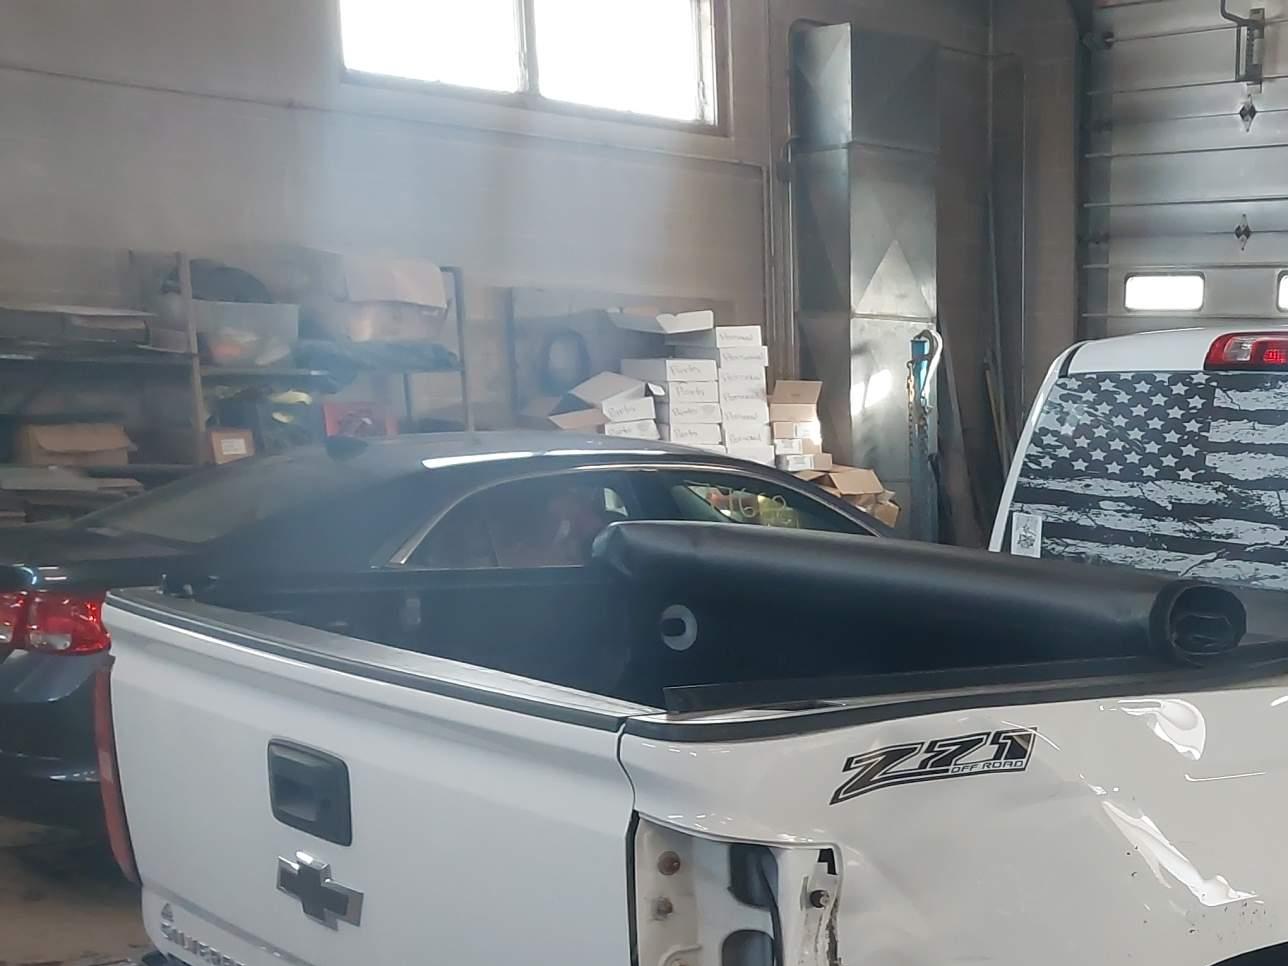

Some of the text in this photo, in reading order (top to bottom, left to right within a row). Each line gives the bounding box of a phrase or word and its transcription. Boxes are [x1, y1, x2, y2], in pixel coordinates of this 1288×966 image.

[829, 727, 1038, 805] Z71
[950, 759, 1024, 774] OFF ROAD
